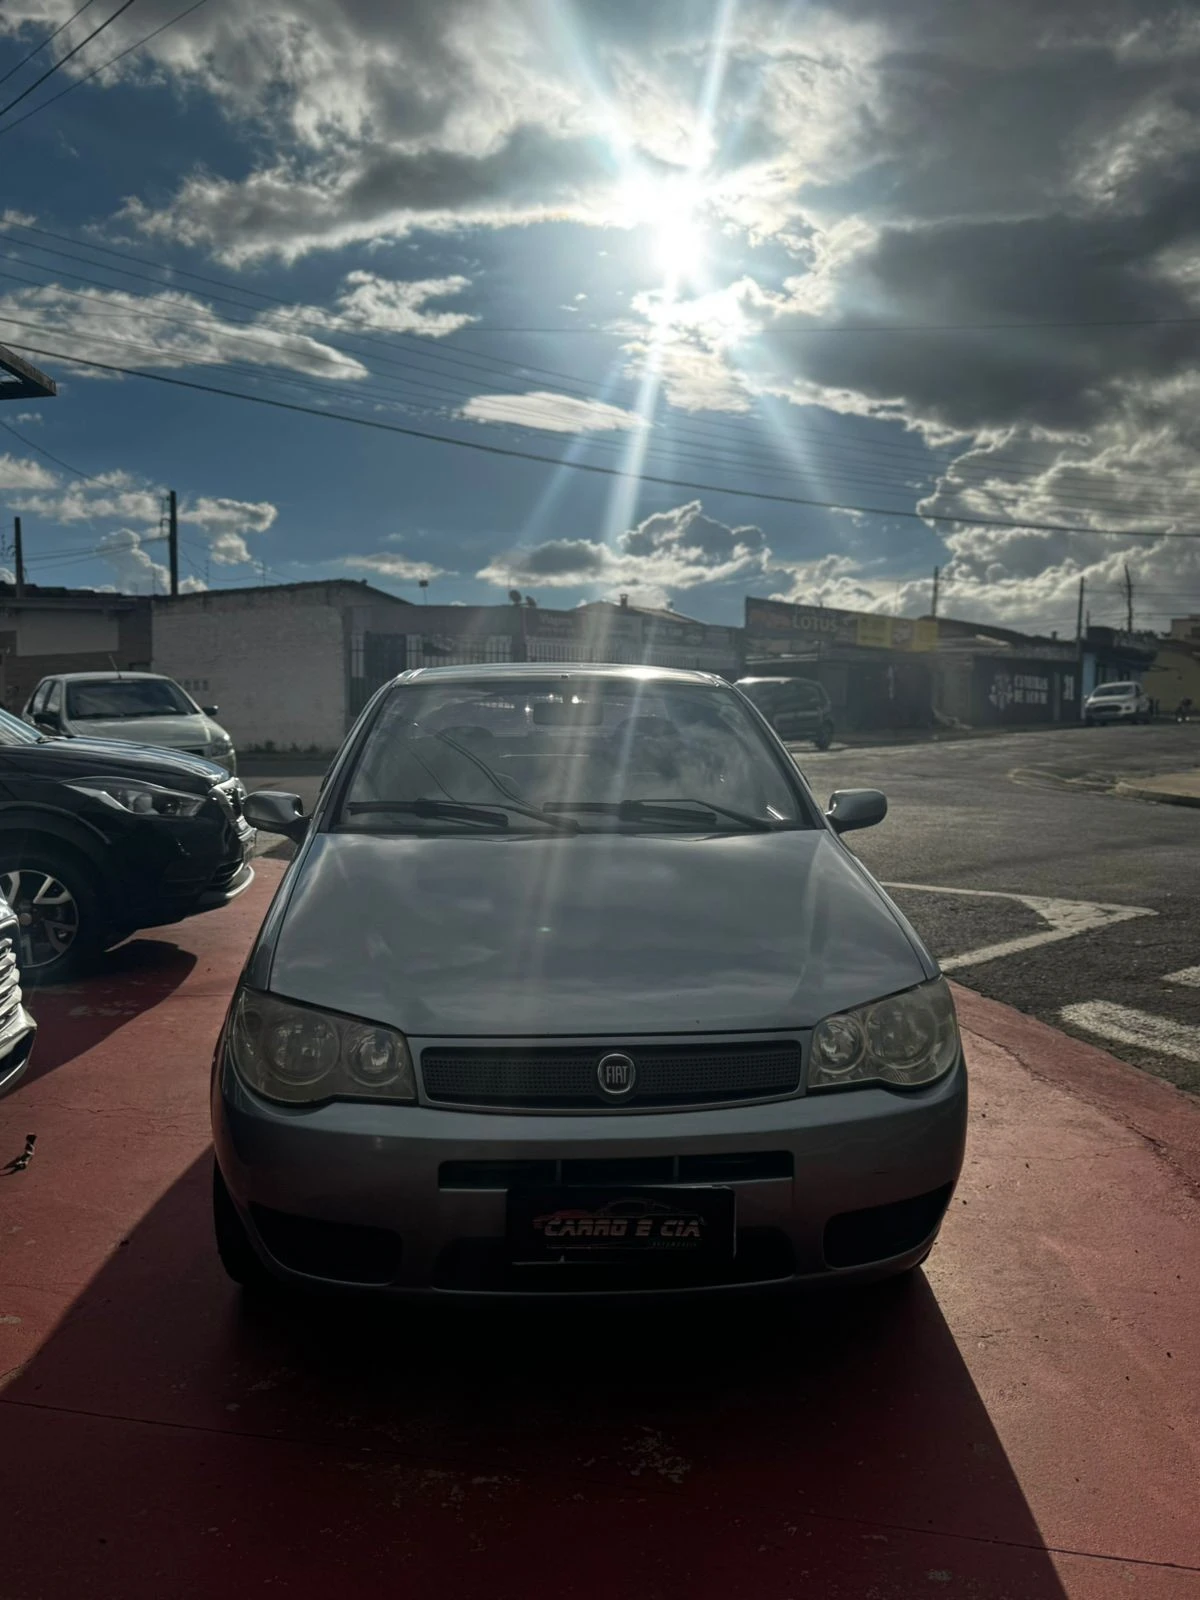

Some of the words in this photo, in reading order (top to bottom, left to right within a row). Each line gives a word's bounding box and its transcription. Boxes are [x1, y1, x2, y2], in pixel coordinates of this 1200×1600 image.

[792, 614, 839, 632] LOTUS
[605, 1065, 628, 1085] FIAT
[544, 1219, 629, 1237] CARRO
[634, 1219, 654, 1237] E
[660, 1219, 701, 1237] CIA
